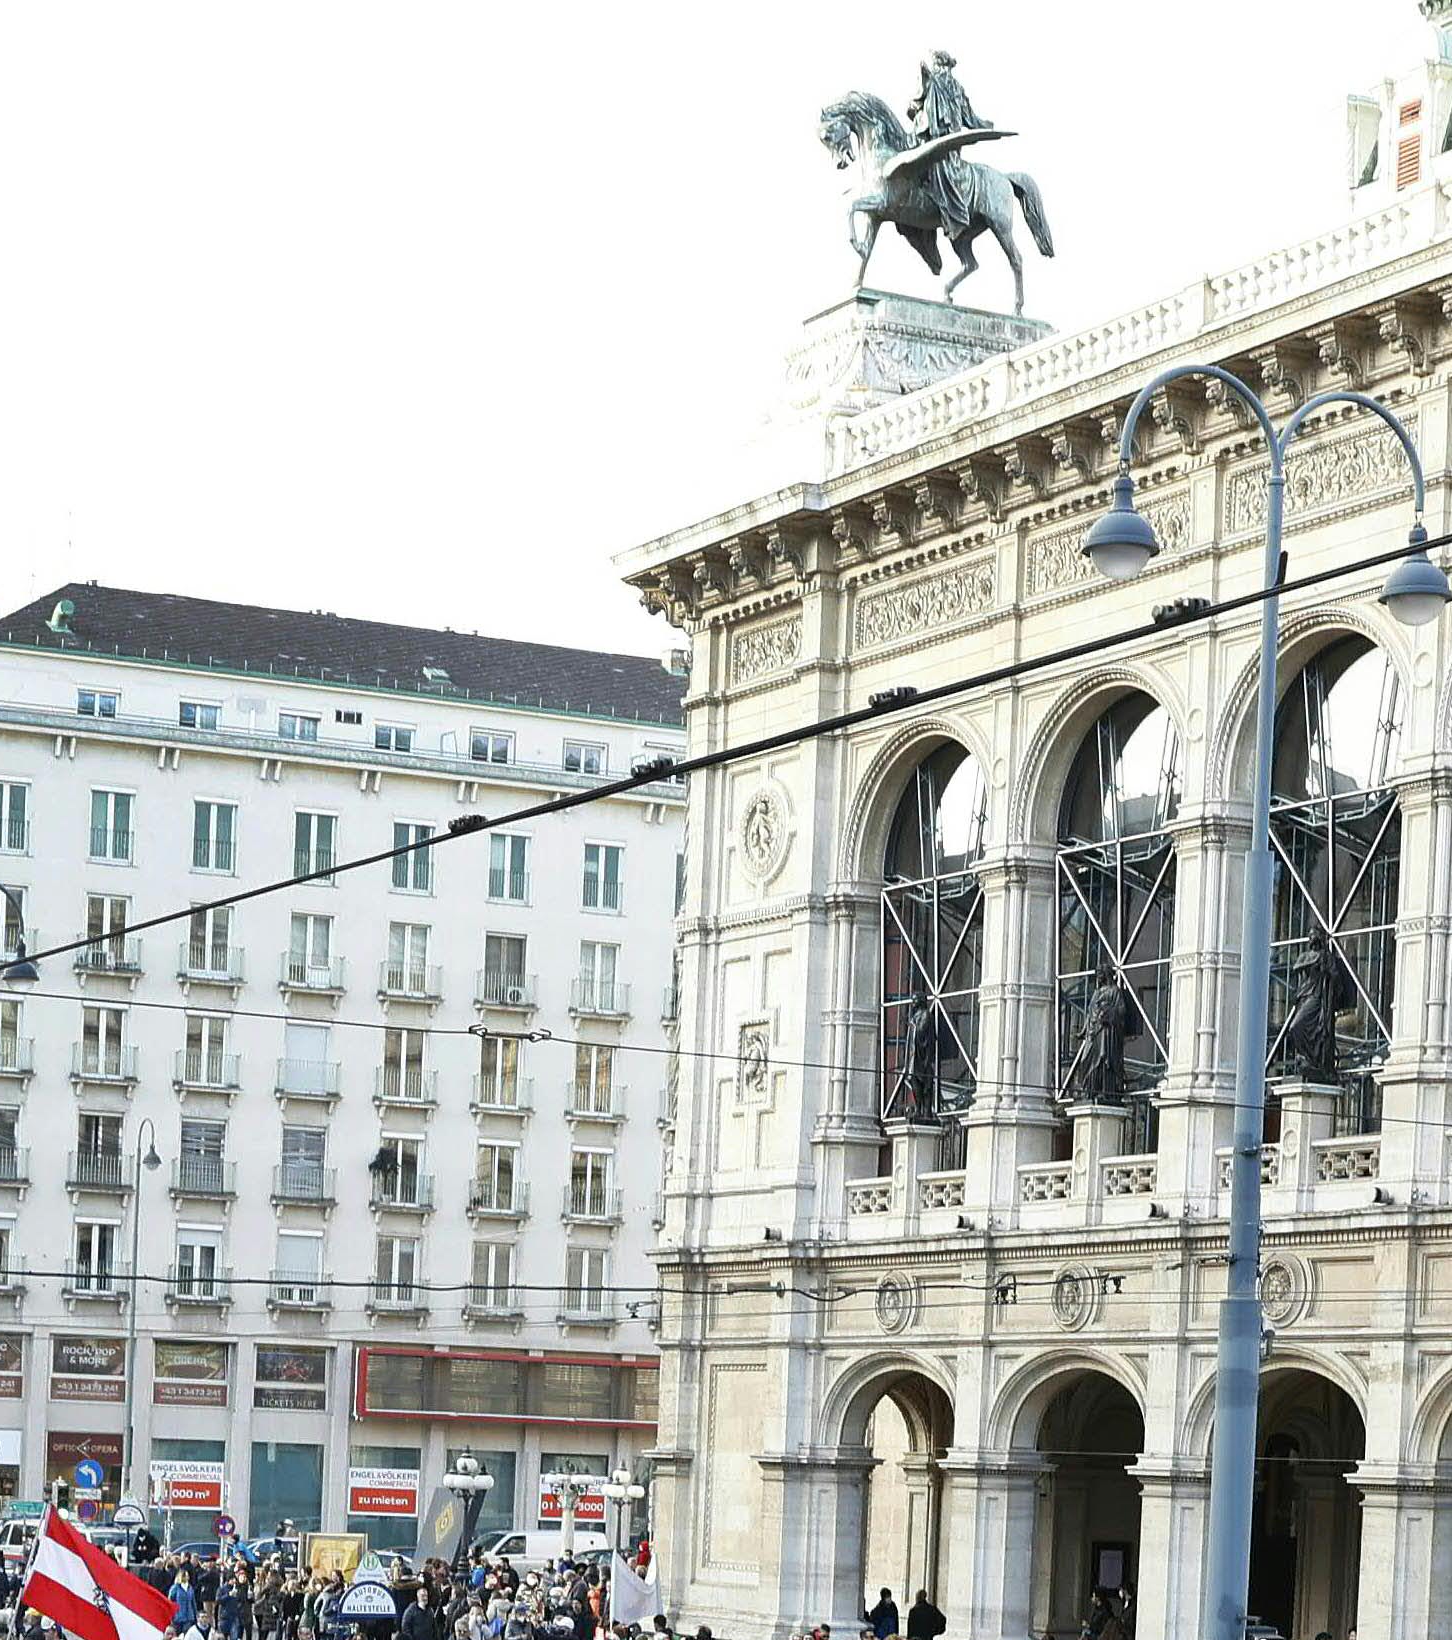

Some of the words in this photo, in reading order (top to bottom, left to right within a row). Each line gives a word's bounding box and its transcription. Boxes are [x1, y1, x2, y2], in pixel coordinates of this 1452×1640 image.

[95, 1347, 117, 1357] POP
[69, 1356, 78, 1365] &
[79, 1357, 107, 1367] MORE
[262, 1398, 294, 1407] TICKETS
[91, 1446, 119, 1454] OPERA
[171, 1472, 221, 1481] COMMERCIAL
[369, 1479, 417, 1488] COMMERCIAL
[358, 1496, 371, 1504] zu
[372, 1495, 408, 1506] mieten
[542, 1501, 553, 1510] 01
[354, 1586, 386, 1599] AUTOBUS
[347, 1604, 391, 1613] HALTESTELLE
